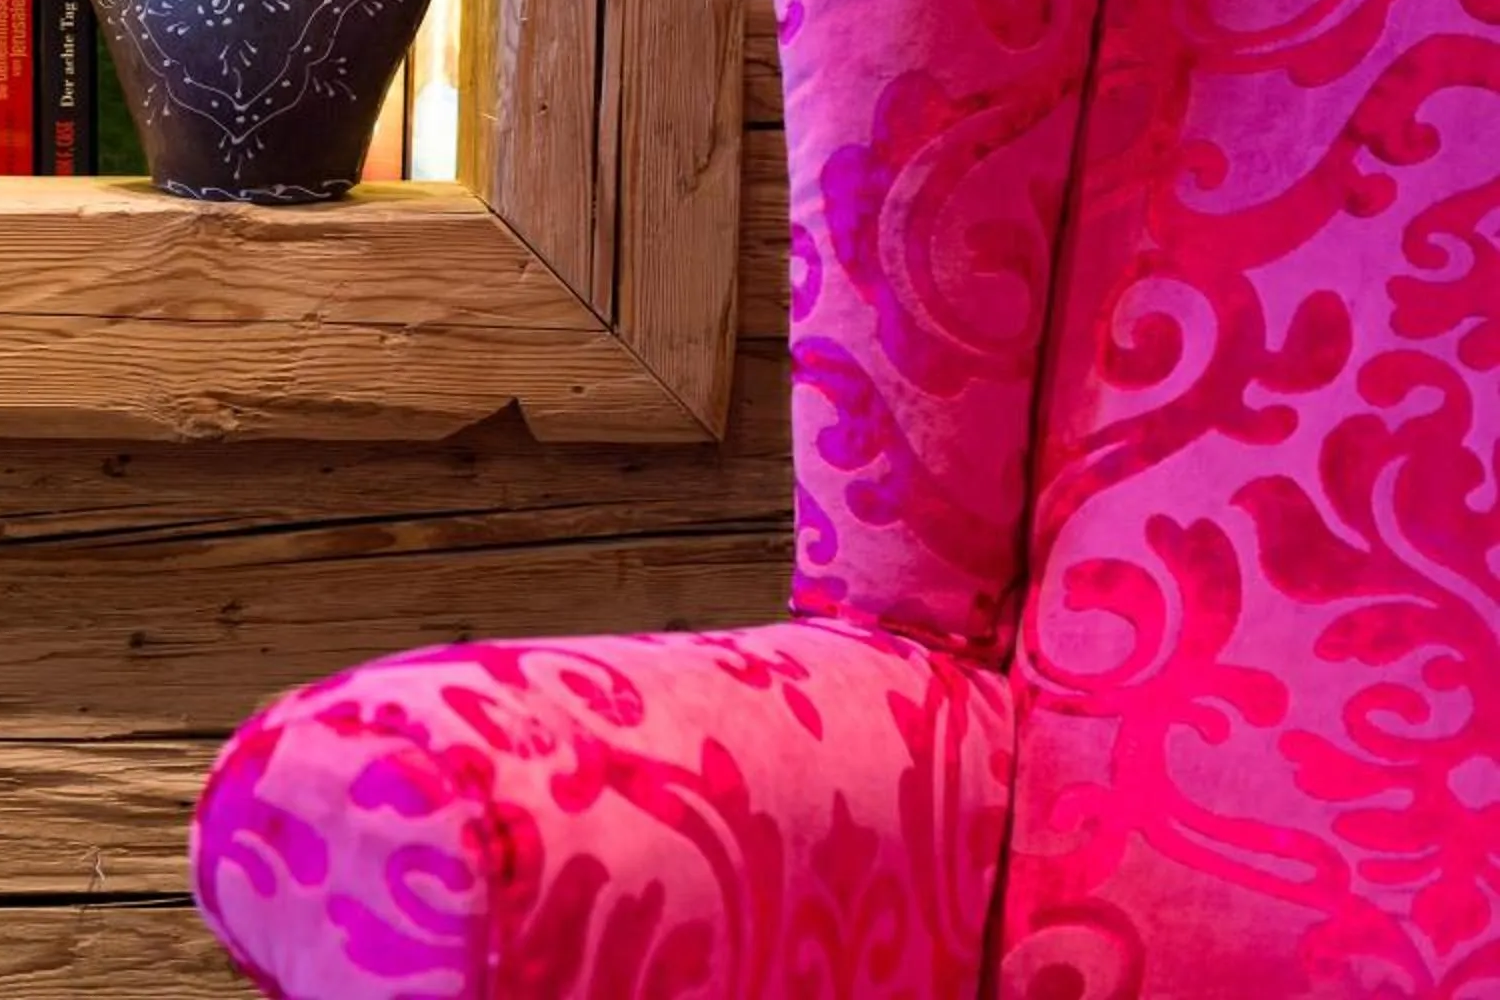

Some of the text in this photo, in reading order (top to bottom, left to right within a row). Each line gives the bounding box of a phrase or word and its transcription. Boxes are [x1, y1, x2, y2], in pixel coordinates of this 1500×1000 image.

[58, 1, 79, 31] Tag
[60, 34, 75, 75] achte
[59, 79, 75, 107] Der
